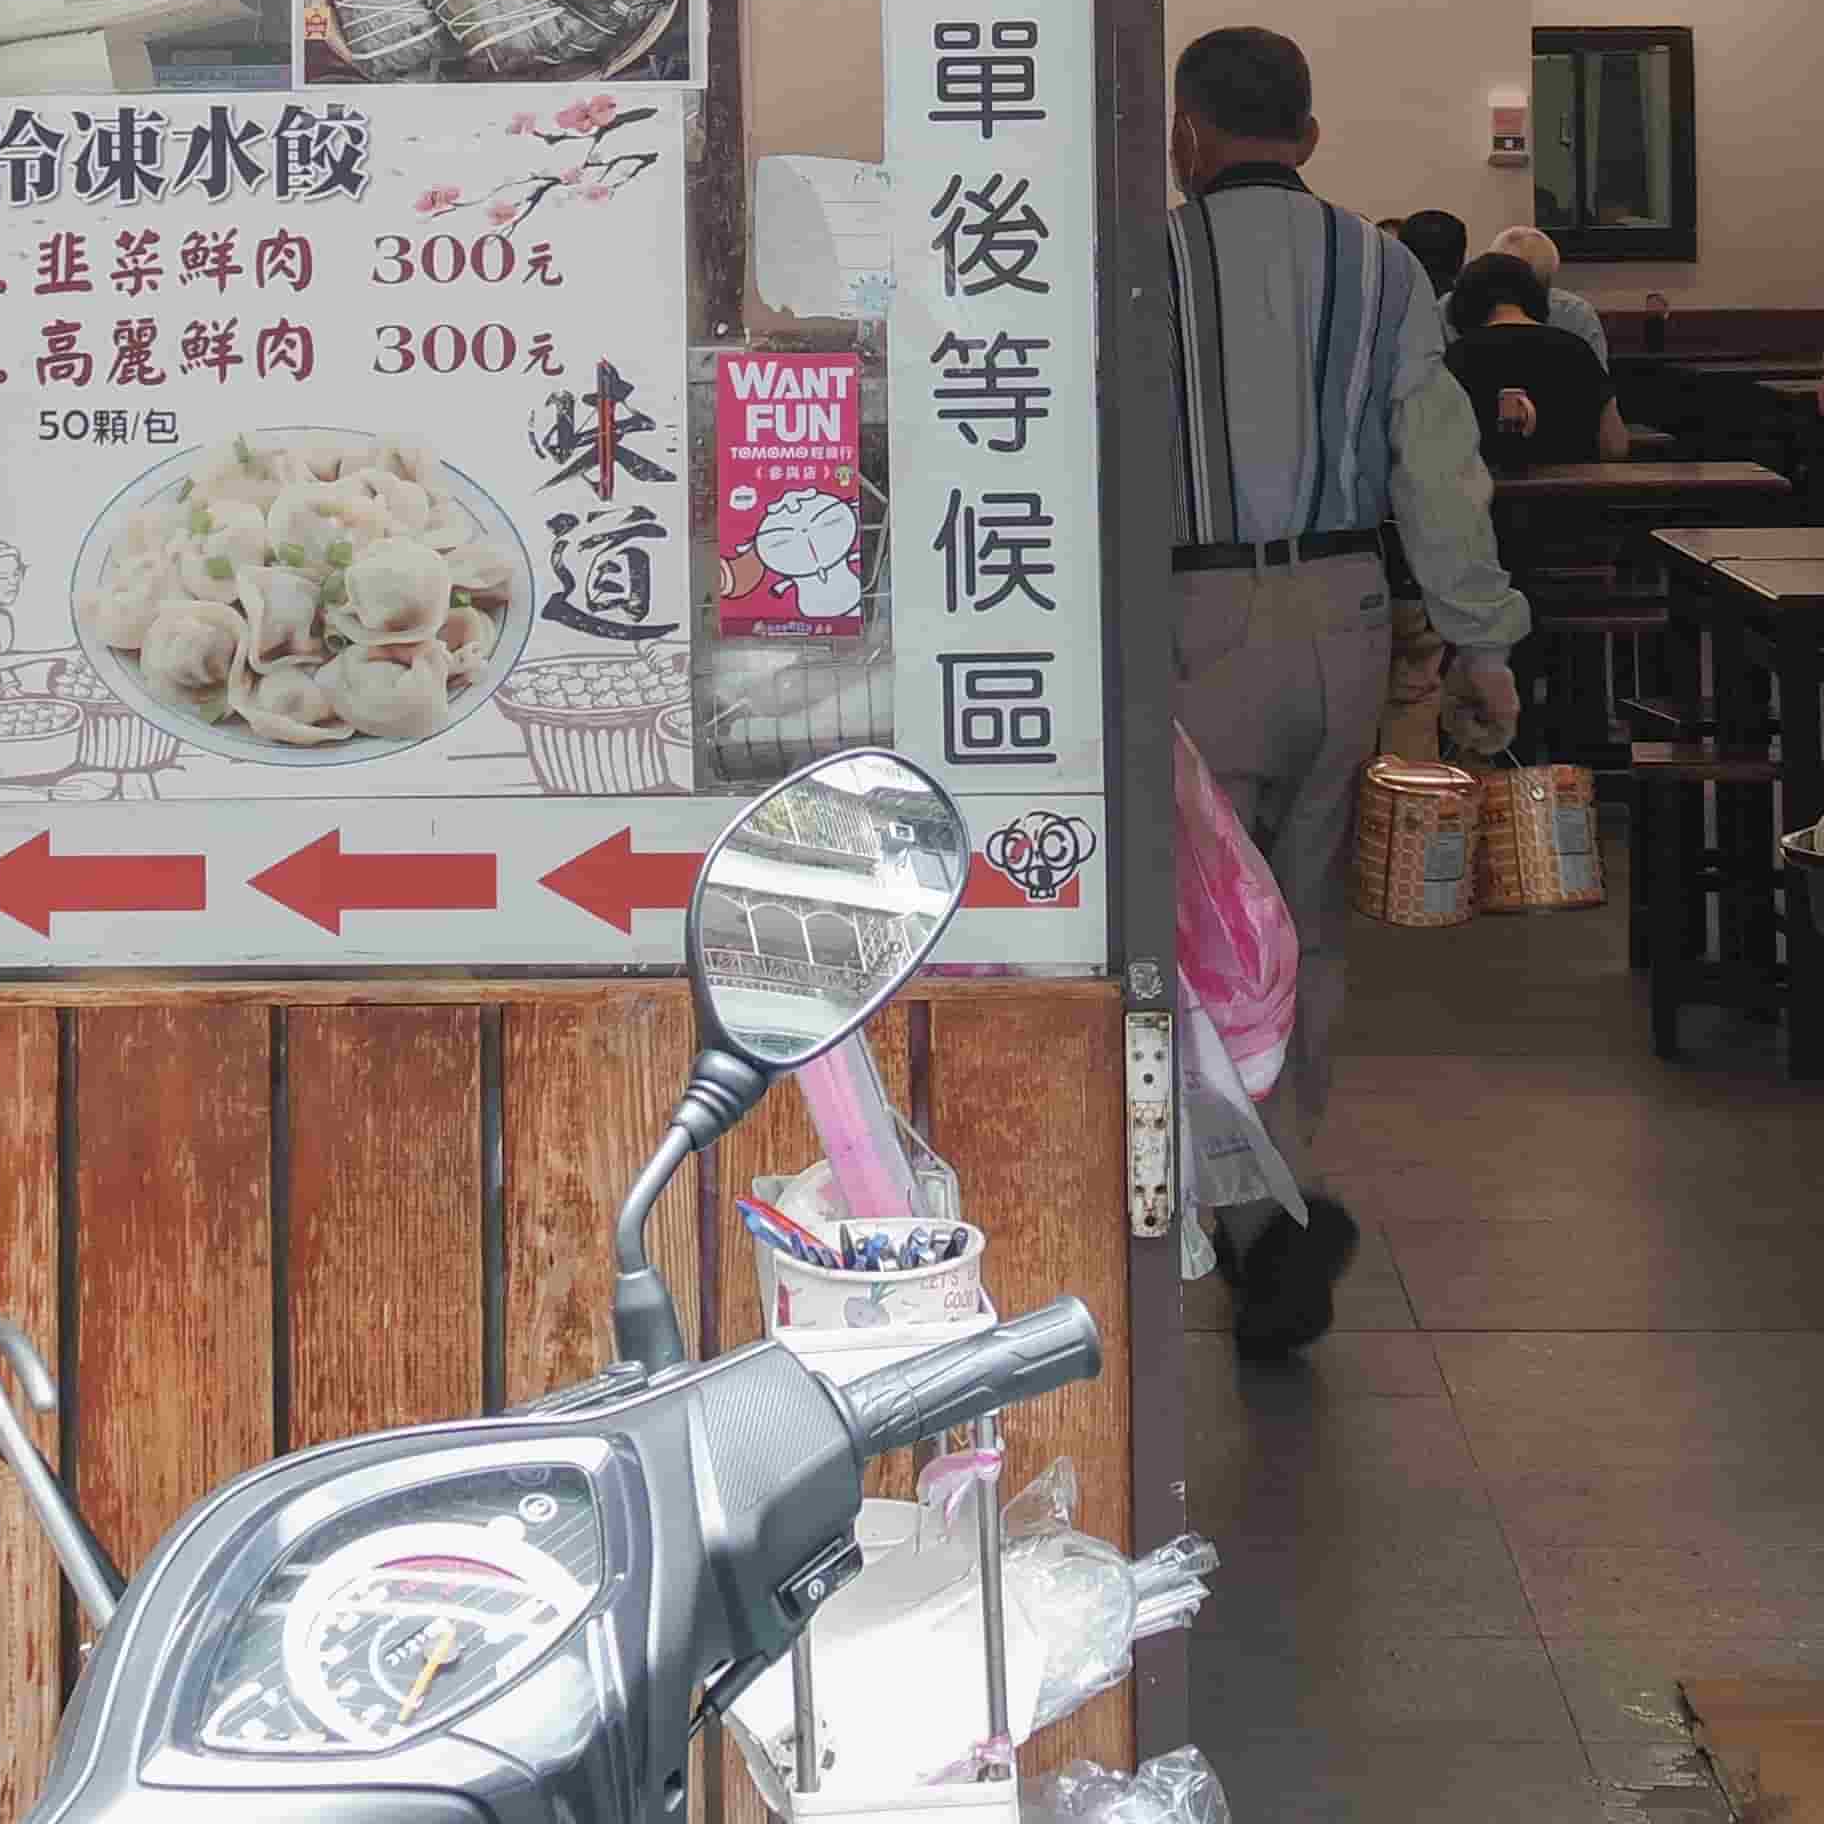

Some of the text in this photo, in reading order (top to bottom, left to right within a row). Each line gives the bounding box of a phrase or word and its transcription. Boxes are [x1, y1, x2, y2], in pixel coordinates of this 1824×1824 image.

[34, 230, 314, 296] 韭菜鮮肉
[371, 233, 565, 288] 300元
[36, 318, 315, 386] 高麗鮮肉
[372, 322, 566, 377] 300元
[727, 361, 854, 399] WANT
[38, 409, 179, 444] 50顆/包
[746, 404, 841, 442] FUN
[529, 358, 679, 642] 味道
